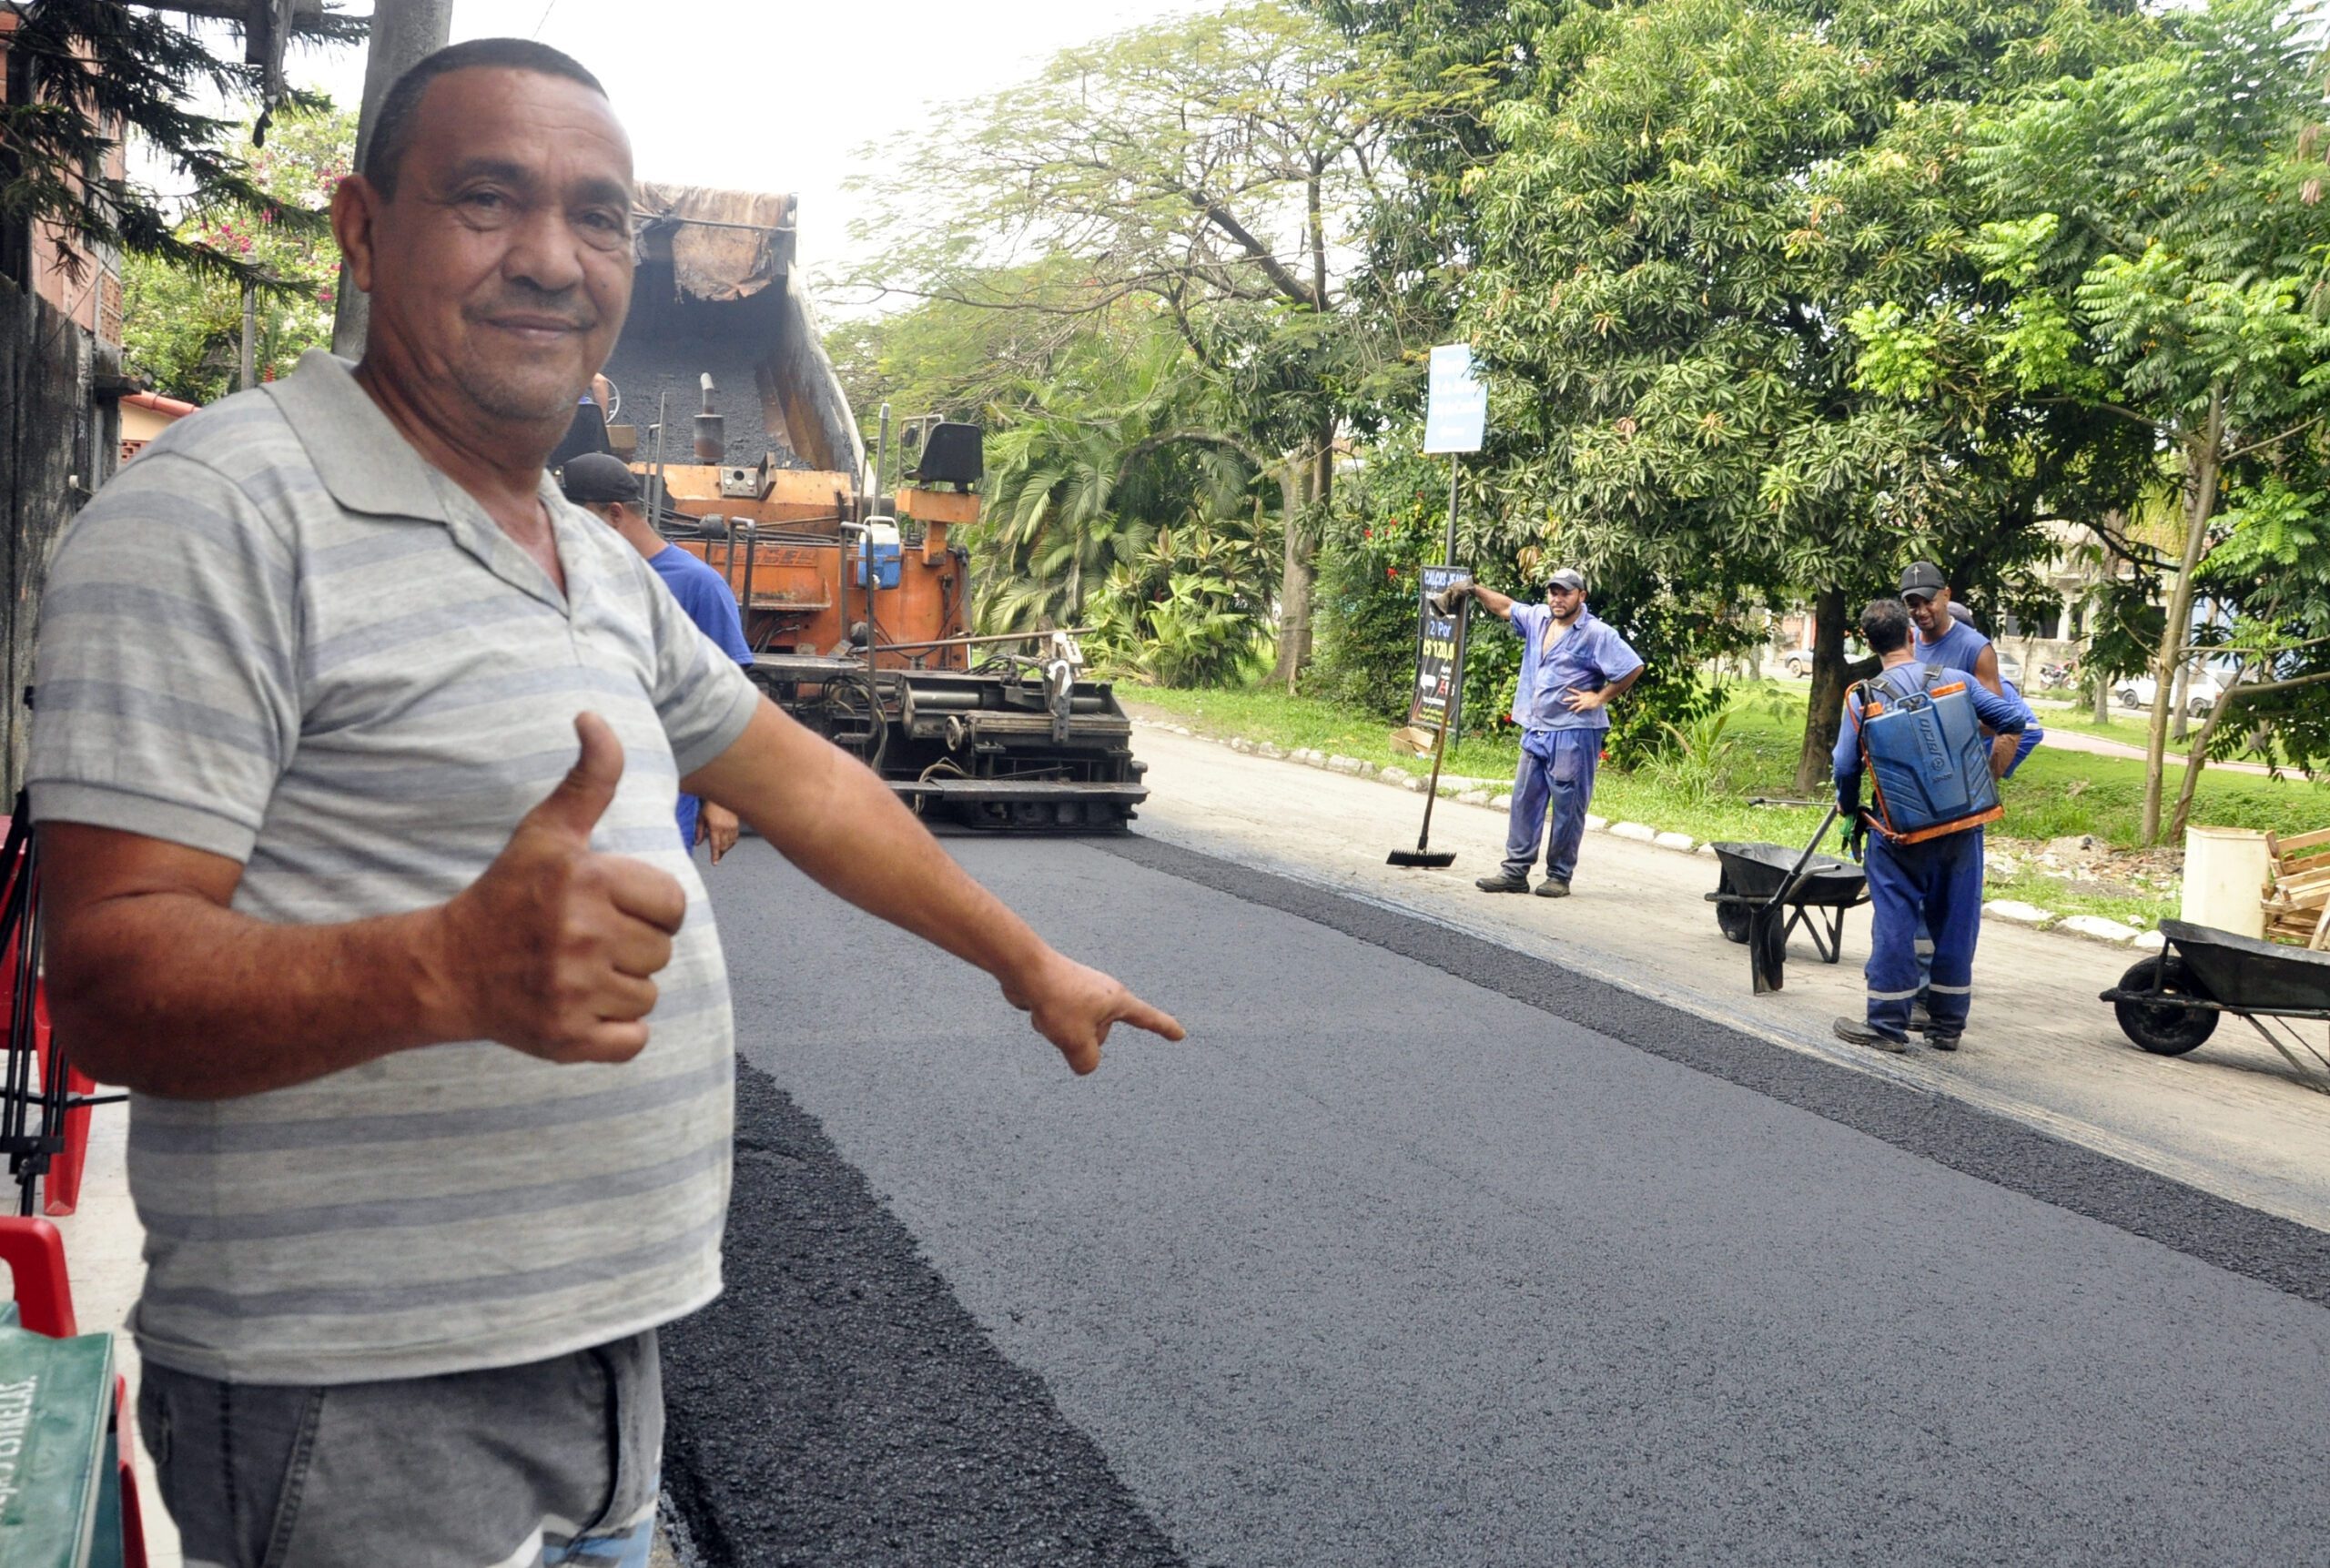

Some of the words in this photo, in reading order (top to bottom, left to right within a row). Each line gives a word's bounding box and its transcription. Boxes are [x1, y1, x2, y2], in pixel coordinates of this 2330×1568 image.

[1430, 621, 1436, 635] 2
[1438, 622, 1452, 638] Por
[1433, 641, 1455, 663] 120,0
